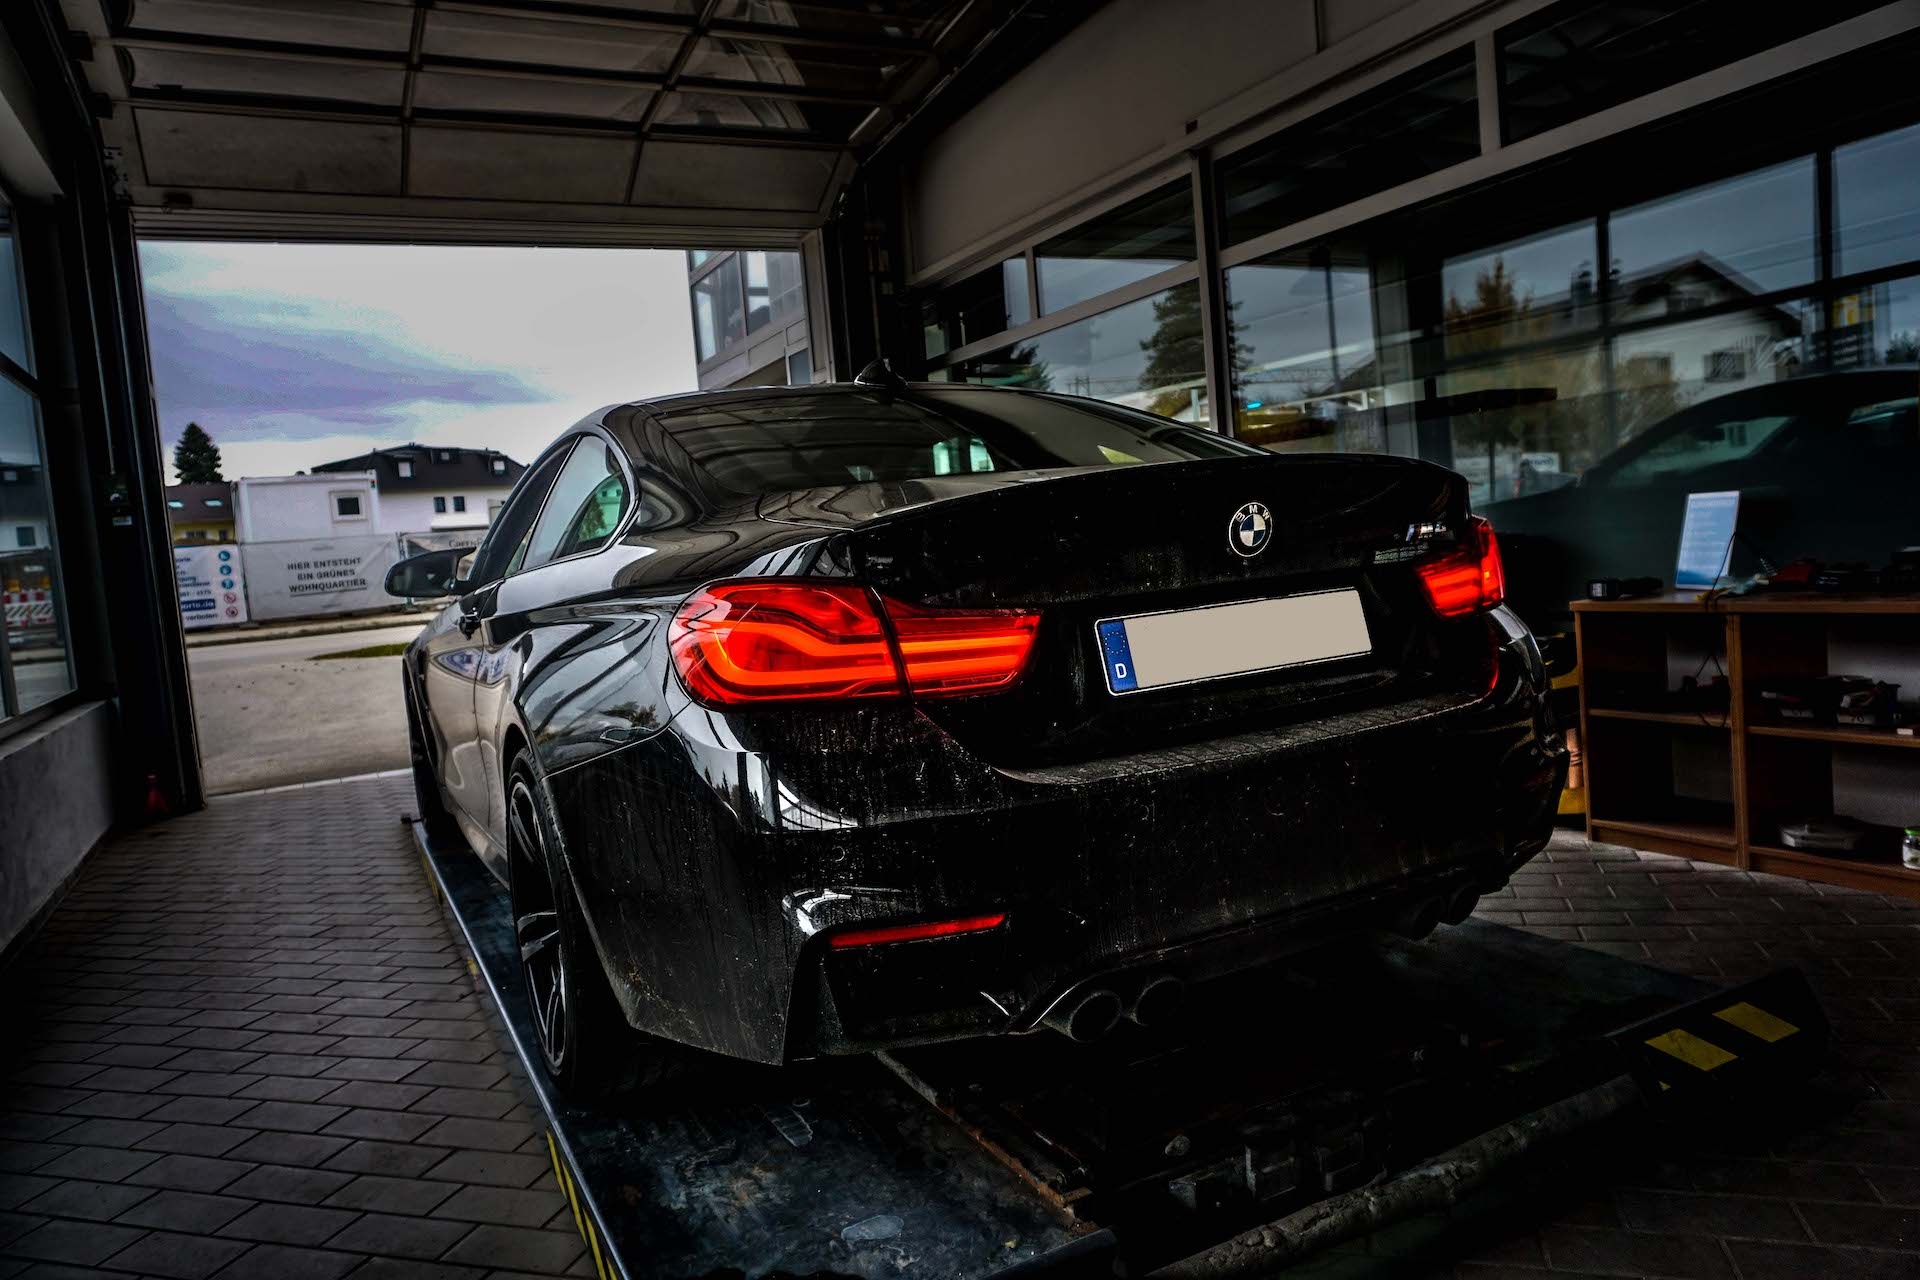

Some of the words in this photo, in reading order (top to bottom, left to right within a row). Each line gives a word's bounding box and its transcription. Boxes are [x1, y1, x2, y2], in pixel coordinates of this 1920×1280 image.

[1235, 504, 1271, 523] BMW
[287, 561, 310, 570] HIER
[313, 557, 361, 568] ENTSTEHT
[297, 572, 313, 581] EIN
[316, 568, 355, 579] GRÜNES
[288, 578, 367, 593] WOHNQUARTIER
[1115, 663, 1127, 679] D
